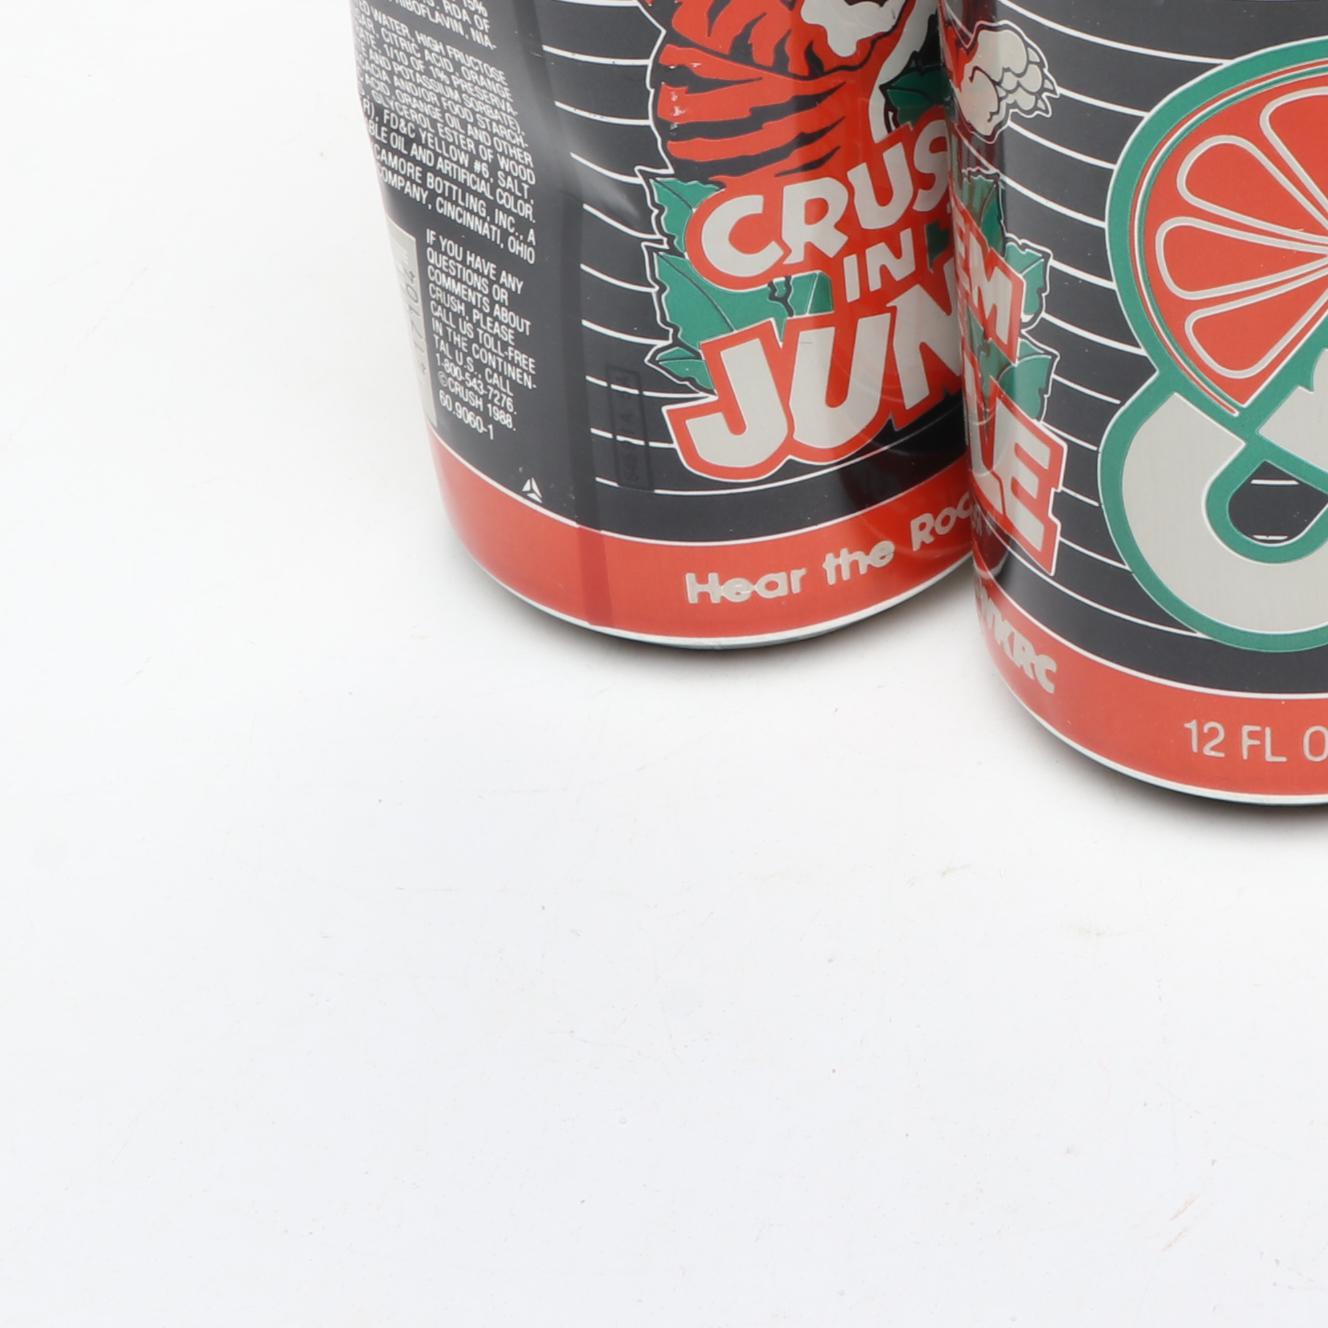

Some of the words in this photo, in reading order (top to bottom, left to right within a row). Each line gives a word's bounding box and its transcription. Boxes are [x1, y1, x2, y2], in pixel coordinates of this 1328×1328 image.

[701, 117, 950, 279] CRUS
[426, 228, 437, 245] IF
[438, 235, 463, 261] YOU
[466, 252, 497, 281] HAVE
[500, 270, 524, 295] ANY
[426, 247, 489, 294] QUESTIONS
[492, 284, 509, 306] OR
[843, 233, 916, 303] IN
[427, 264, 490, 312] COMMENTS
[493, 303, 531, 336] ABOUT
[472, 308, 515, 345] PLEASE
[430, 300, 454, 328] CALL
[458, 317, 474, 339] US
[477, 327, 536, 374] TOLL-FREE
[432, 318, 443, 338] IN
[446, 327, 468, 353] THE
[472, 341, 537, 391] CONTINEN-
[432, 335, 452, 360] TAL
[485, 367, 514, 397] CALL
[684, 261, 961, 469] JUN
[685, 566, 807, 605] Hear
[822, 540, 896, 586] the
[1183, 720, 1226, 758] 12
[1241, 724, 1287, 764] FL
